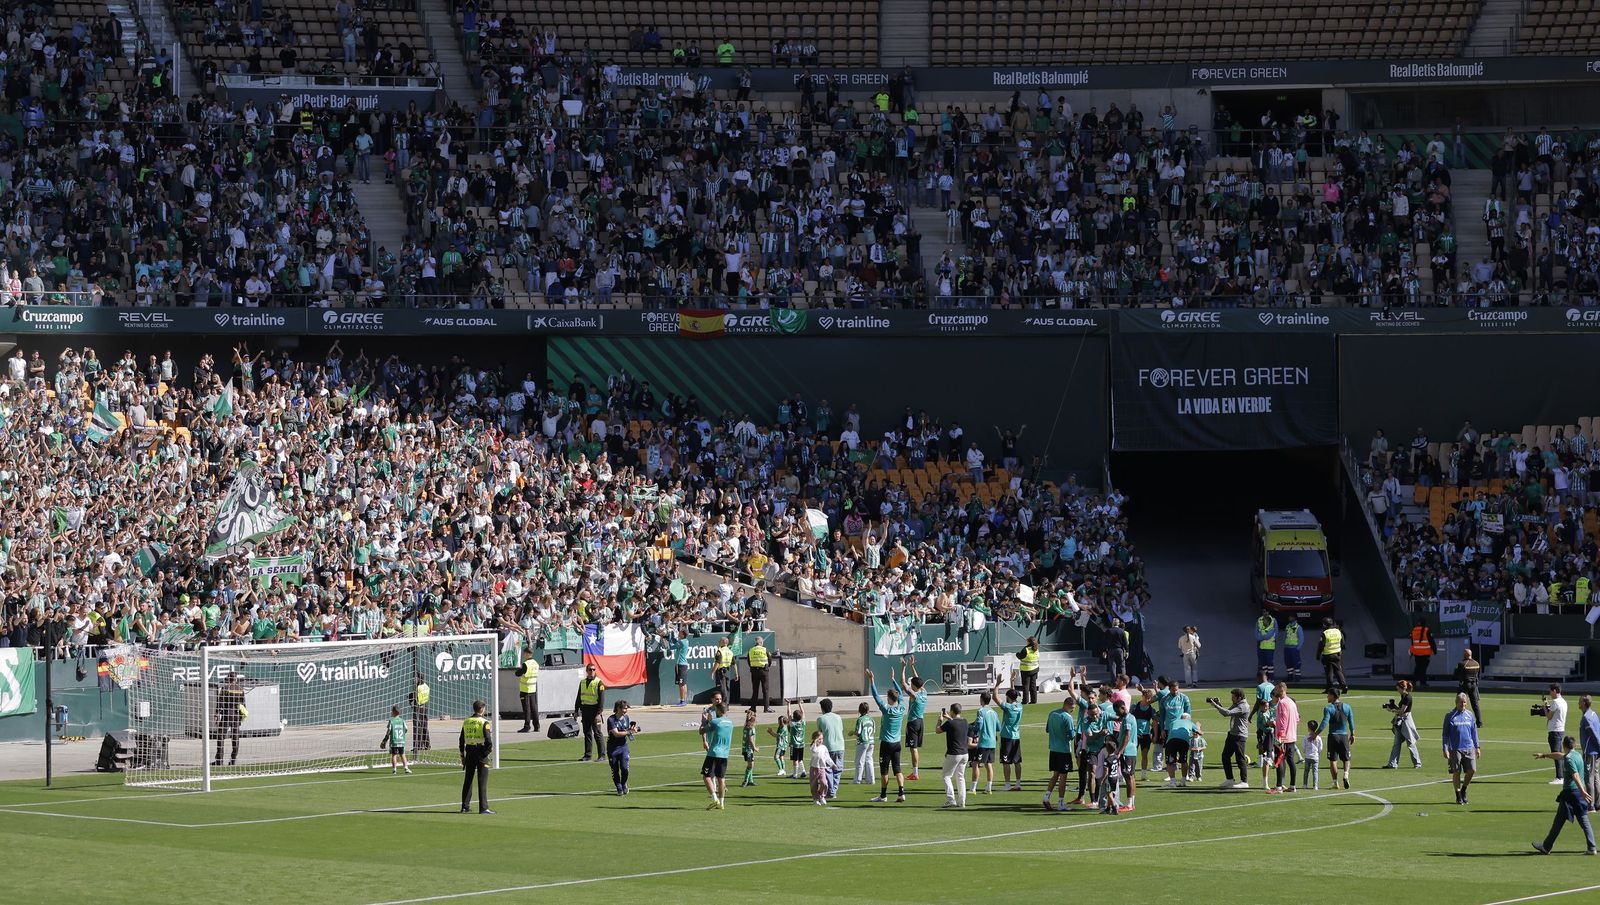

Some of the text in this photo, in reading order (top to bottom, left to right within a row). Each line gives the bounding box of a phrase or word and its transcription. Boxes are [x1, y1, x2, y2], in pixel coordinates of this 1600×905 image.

[1192, 67, 1287, 80] FOREVER GREEN
[1390, 61, 1483, 78] Real Betis Balompié
[617, 72, 641, 86] Betis
[852, 74, 889, 85] GREEN
[993, 69, 1088, 86] Real Betis Balompié
[22, 309, 84, 324] Cruzcampo
[119, 313, 174, 322] REVEL
[232, 314, 285, 326] trainline
[340, 313, 384, 323] GREE
[433, 318, 497, 326] AUS GLOBAL
[641, 312, 680, 323] FOREVE
[740, 316, 770, 326] GRE
[836, 316, 890, 328] trainline
[928, 313, 988, 327] Cruzcampo
[1033, 318, 1098, 326] AUS GLOBAL
[1179, 312, 1221, 322] GREE
[1276, 313, 1330, 325] trainline
[1370, 312, 1425, 321] REVEL
[1467, 309, 1528, 323] Cruzcampo
[548, 317, 597, 328] CaixaBank
[1139, 367, 1309, 388] FOREVER GREEN
[1177, 396, 1272, 414] LA VIDA EN VERDE
[252, 568, 264, 577] LA
[1444, 604, 1466, 614] PEÑA
[917, 636, 962, 652] aixaBank
[457, 654, 492, 671] GRE
[320, 659, 389, 681] trainline
[394, 729, 404, 739] 12
[863, 726, 875, 741] 12
